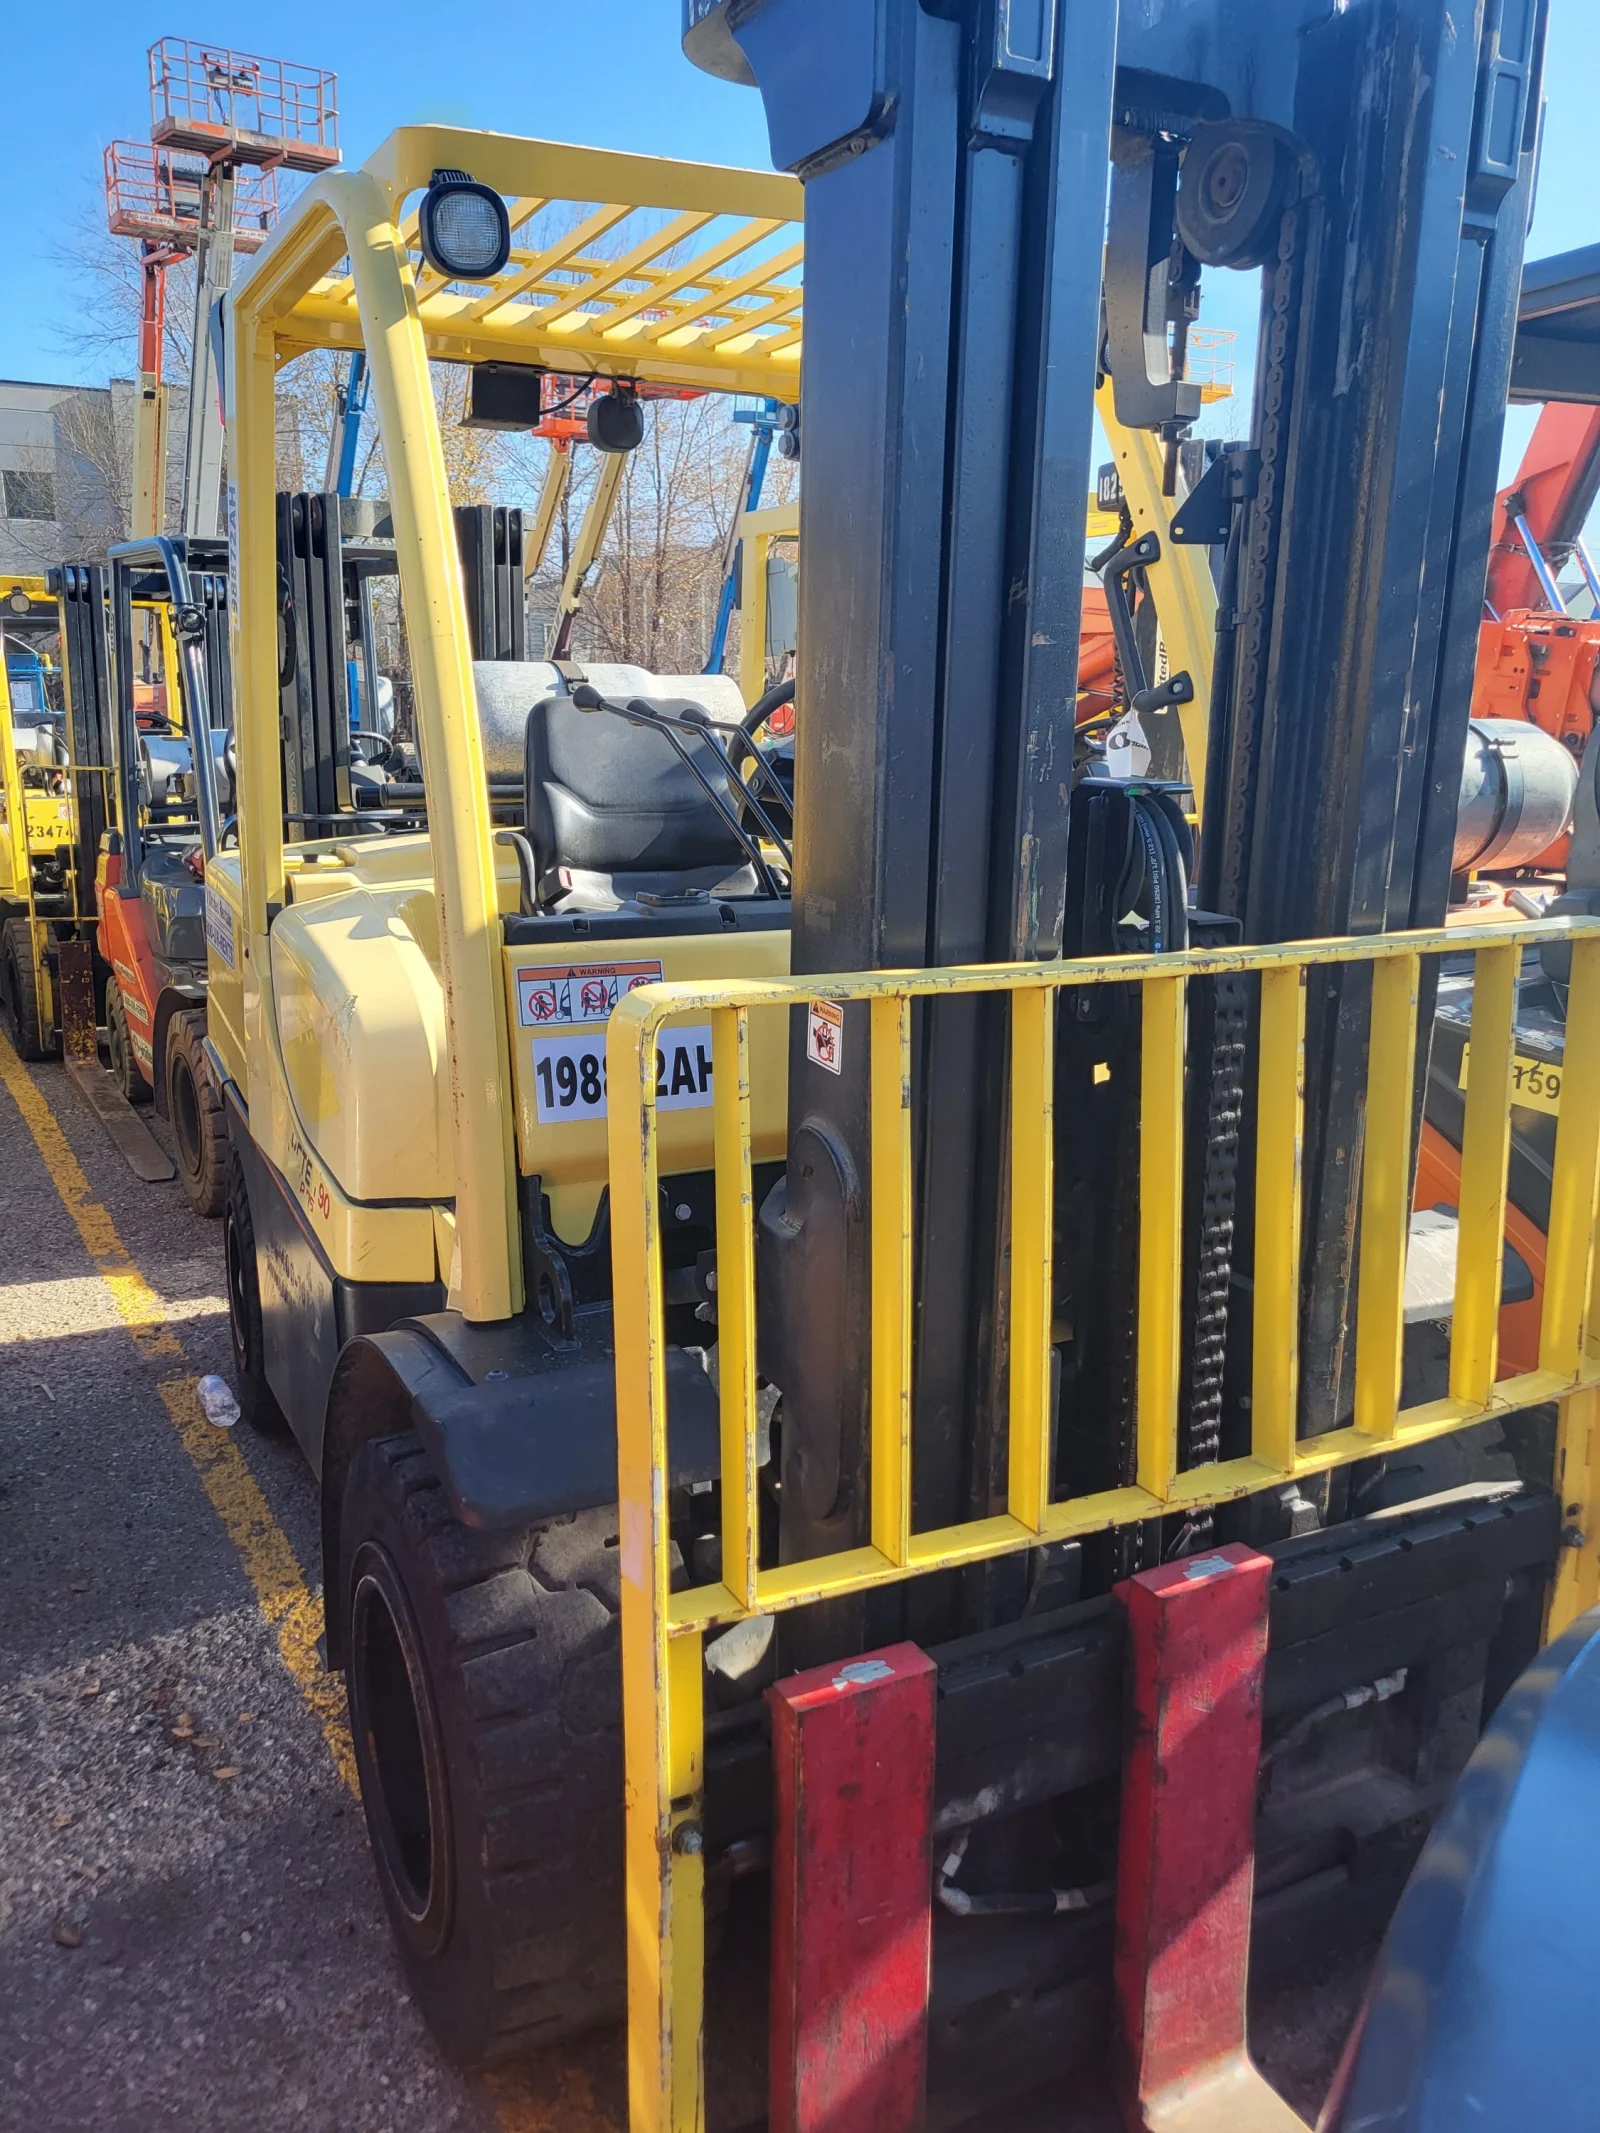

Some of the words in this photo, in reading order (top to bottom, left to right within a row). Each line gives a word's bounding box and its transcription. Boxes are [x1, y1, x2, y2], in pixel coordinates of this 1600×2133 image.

[227, 486, 239, 624] 98872AH
[579, 966, 616, 976] WARNING
[820, 1006, 840, 1022] WARNING
[536, 1044, 713, 1108] 1982AH
[317, 1182, 331, 1220] 90
